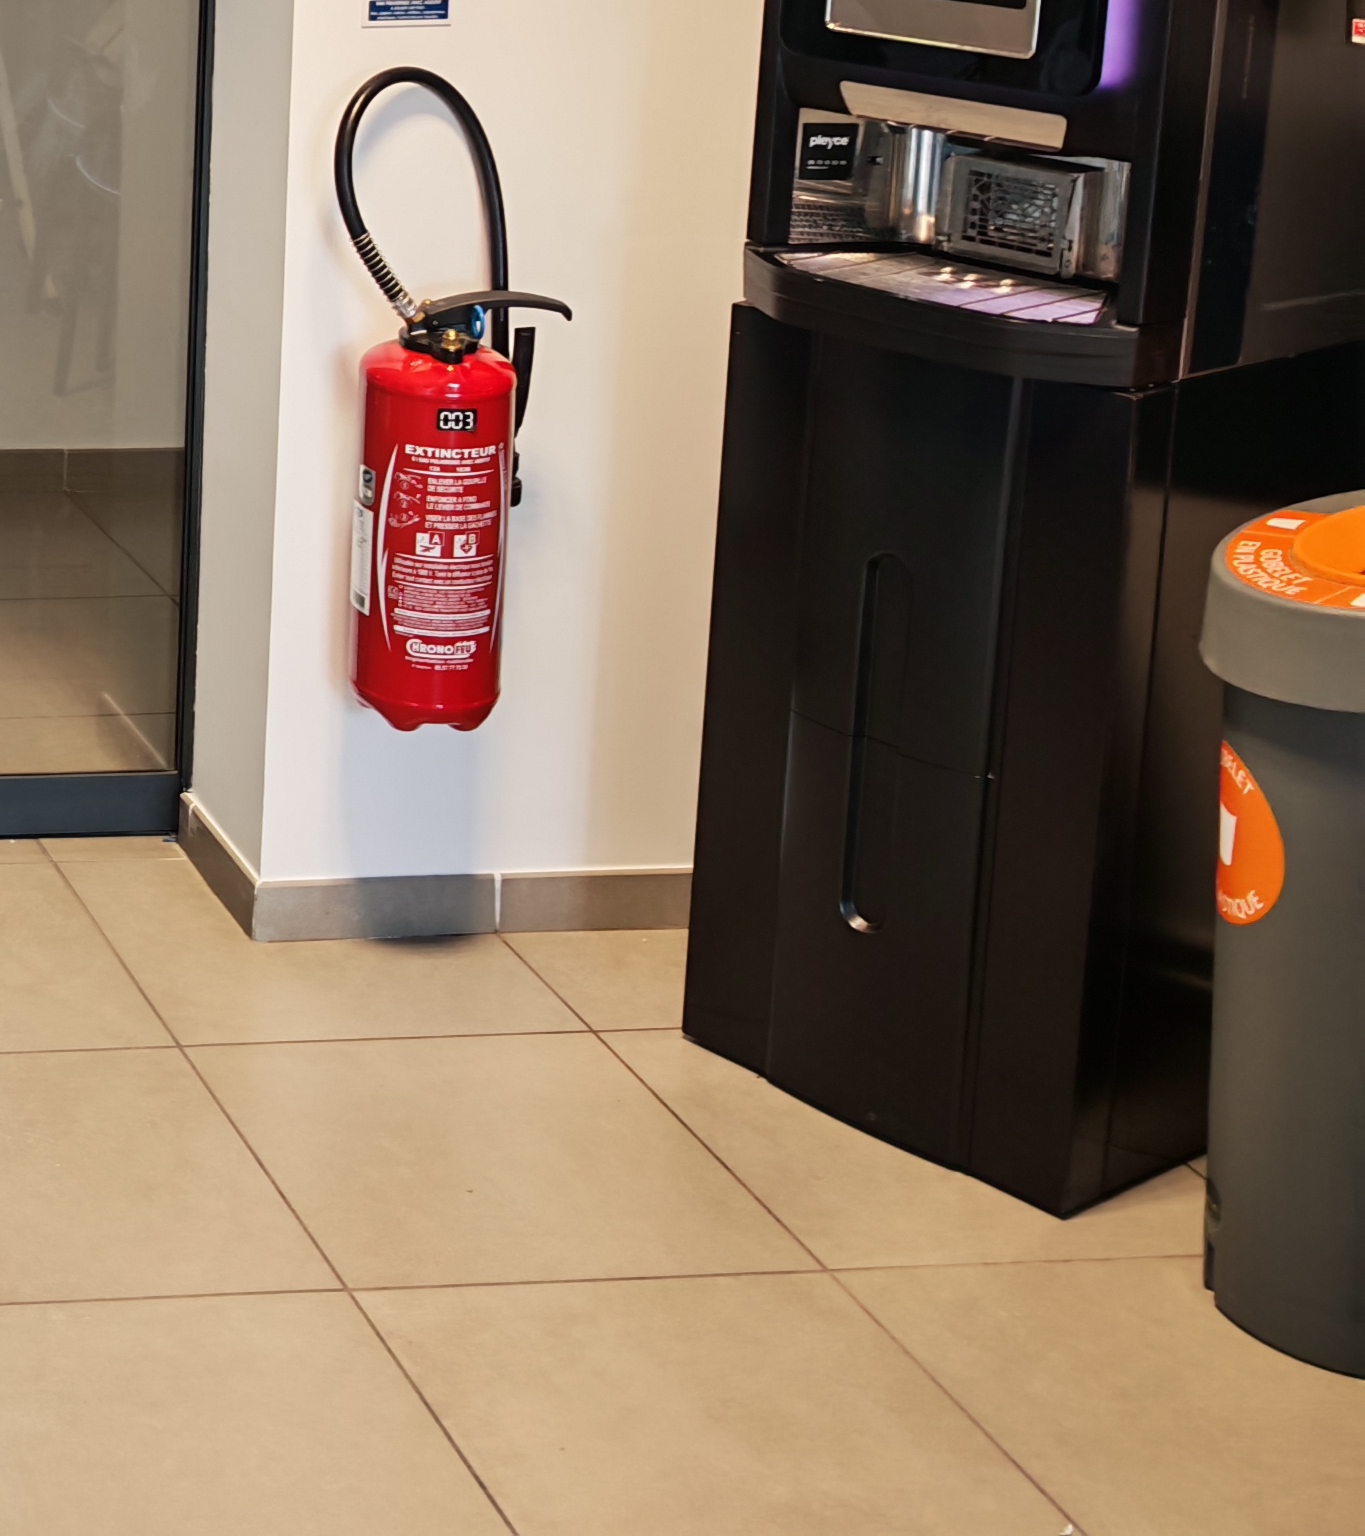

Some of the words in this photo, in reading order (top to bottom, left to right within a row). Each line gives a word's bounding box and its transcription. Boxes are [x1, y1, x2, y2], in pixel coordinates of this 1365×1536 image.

[439, 411, 474, 429] 003
[405, 444, 496, 458] EXTINCTEUR
[431, 534, 441, 545] A
